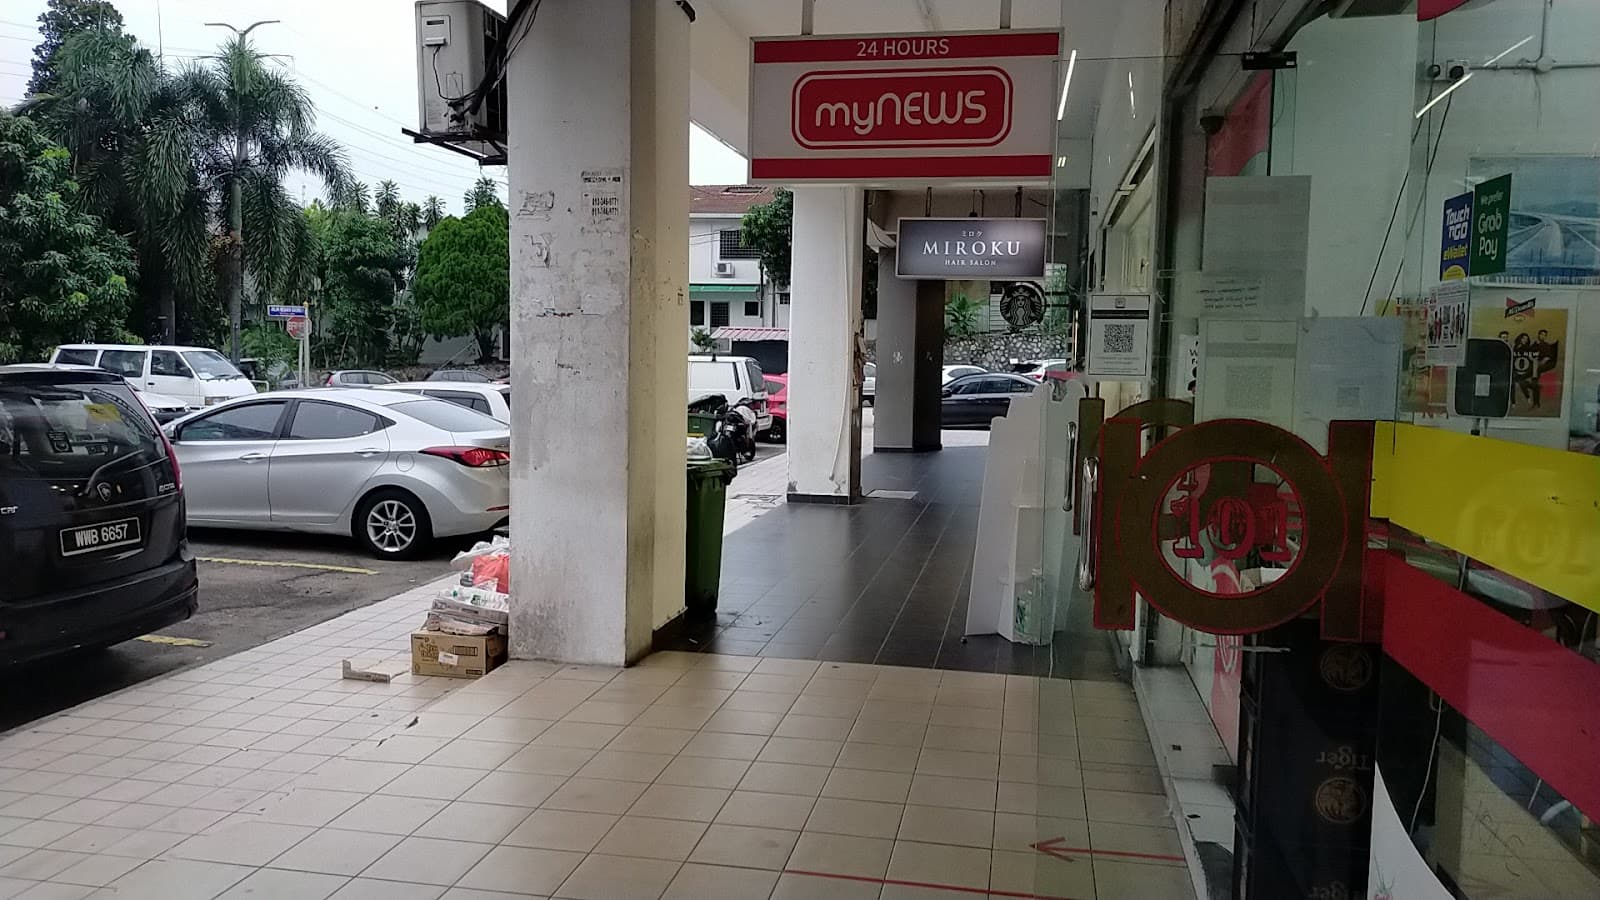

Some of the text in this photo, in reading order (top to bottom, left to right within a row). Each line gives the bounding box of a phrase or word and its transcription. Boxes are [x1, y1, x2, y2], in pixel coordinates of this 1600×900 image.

[857, 39, 950, 57] 24 HOURS
[1445, 204, 1470, 226] Touch
[1478, 208, 1502, 234] Grab
[922, 241, 1021, 256] MIROKU
[1479, 236, 1498, 260] Pay
[75, 523, 129, 547] WWB 6657
